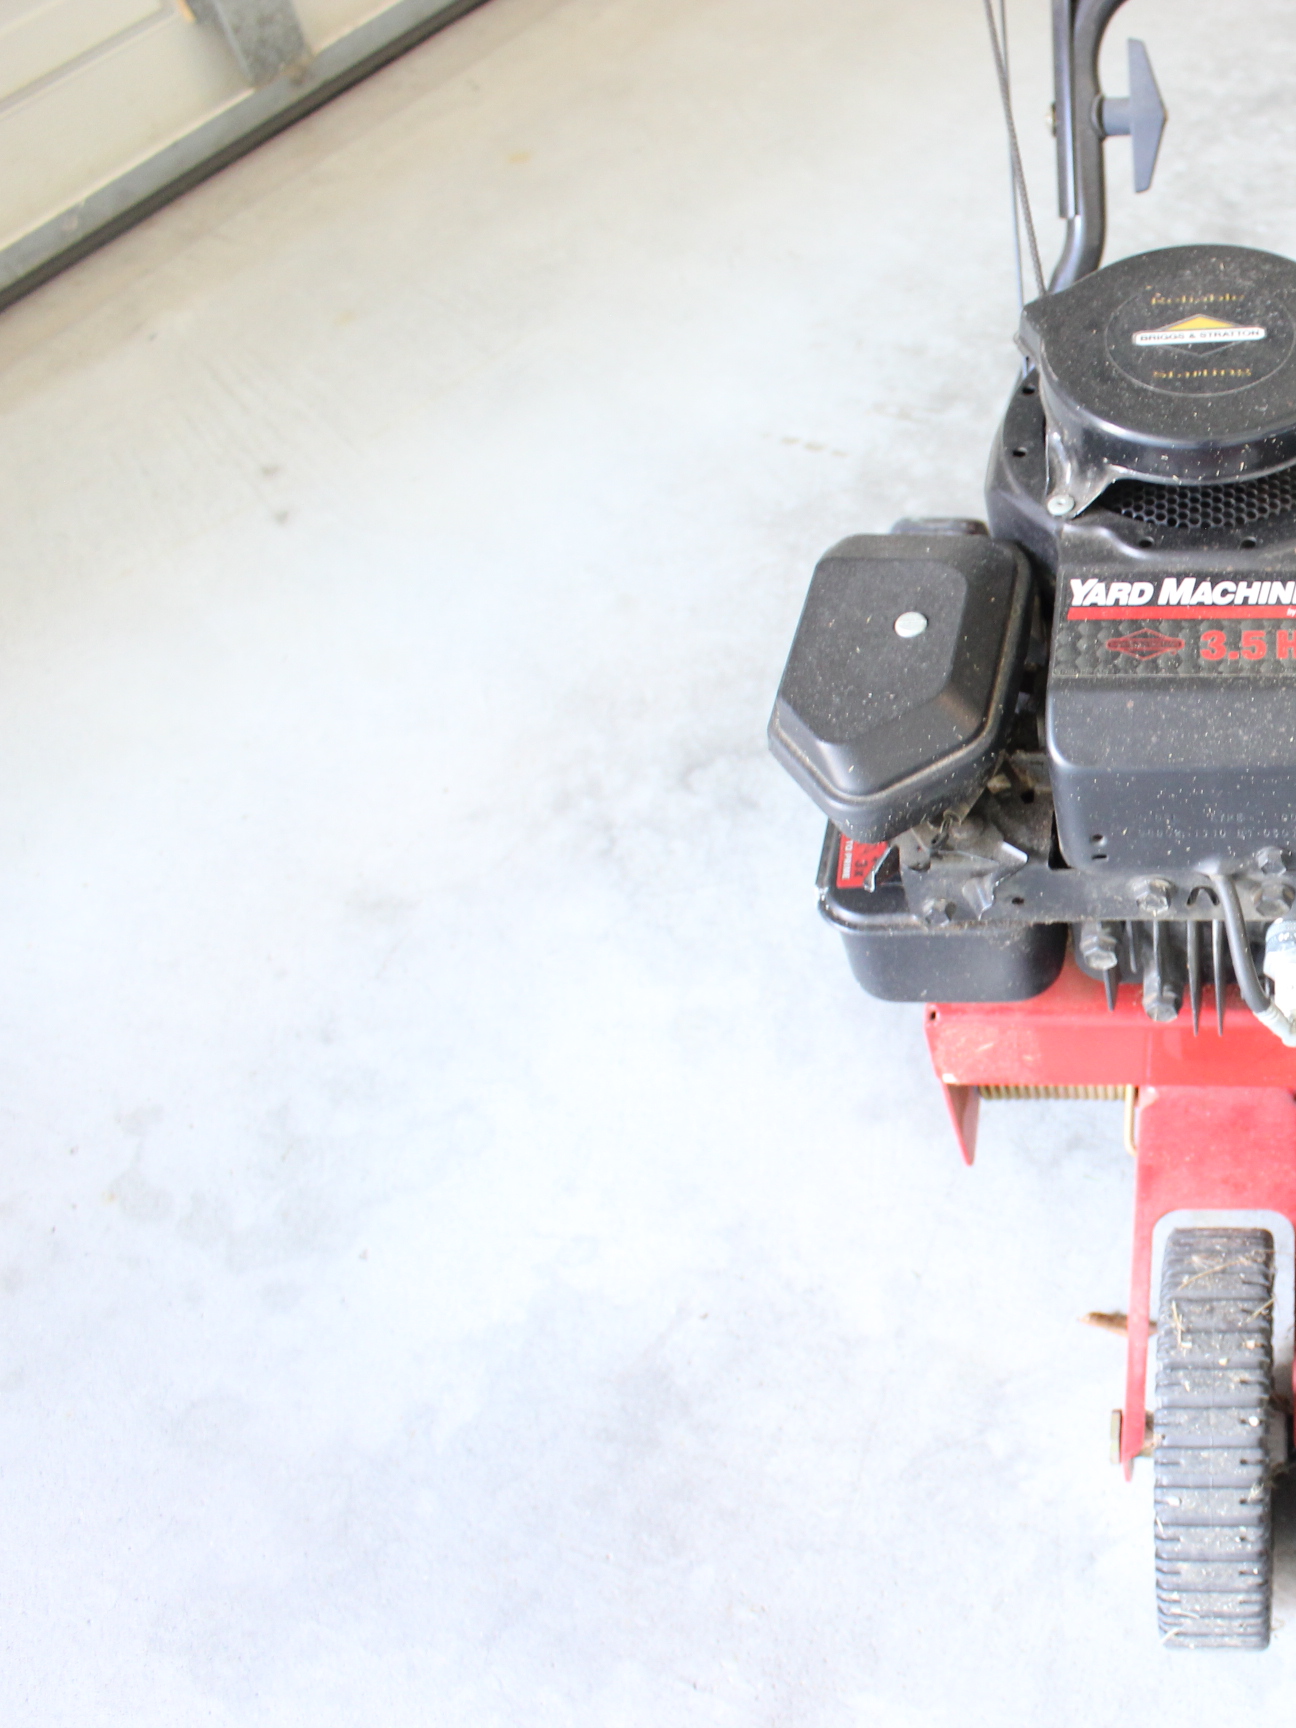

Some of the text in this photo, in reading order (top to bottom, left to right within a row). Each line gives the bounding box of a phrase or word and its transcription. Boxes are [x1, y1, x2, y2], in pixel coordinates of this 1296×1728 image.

[1140, 333, 1185, 341] BRIGGS
[1199, 329, 1260, 339] STRATTON
[1069, 577, 1155, 607] YARD
[1200, 629, 1267, 661] 3.5
